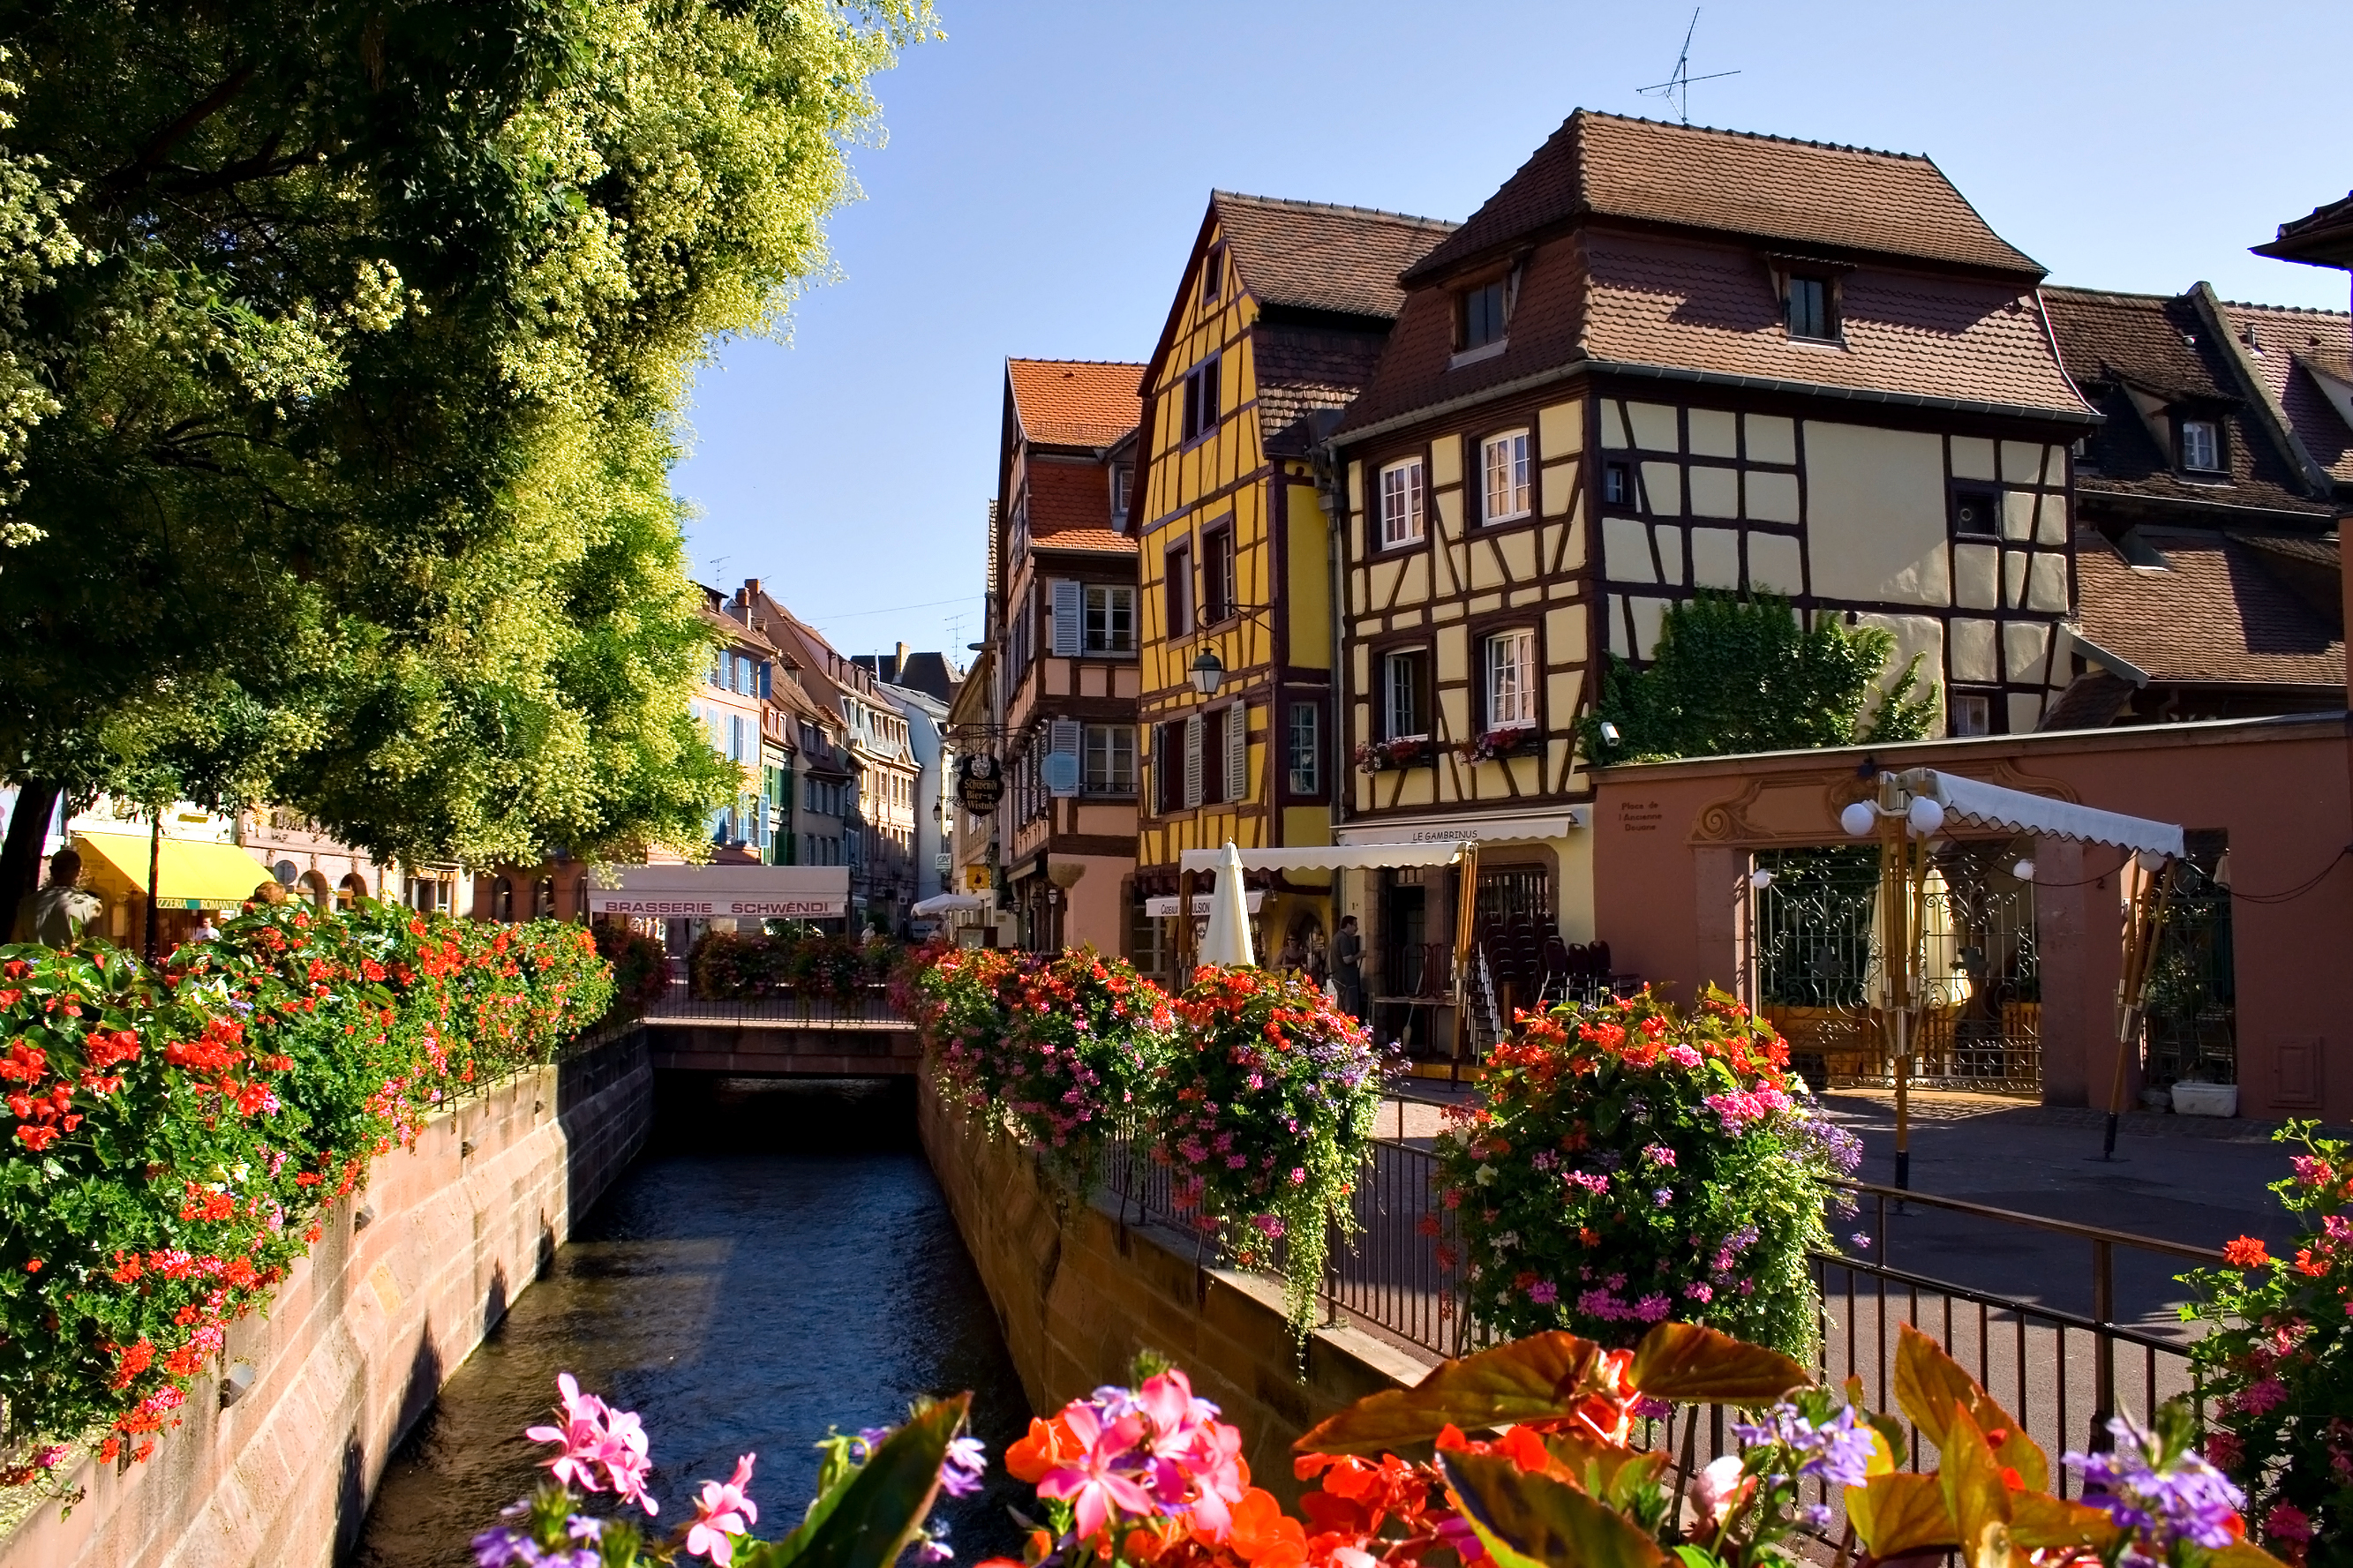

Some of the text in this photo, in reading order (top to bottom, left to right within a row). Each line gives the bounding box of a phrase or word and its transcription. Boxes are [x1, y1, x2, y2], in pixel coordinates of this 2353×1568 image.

[964, 778, 997, 791] Schwendi
[966, 800, 994, 810] Wistub
[1413, 830, 1477, 841] LE GAMBRINUS
[605, 901, 828, 914] BRASSERIE SCHWENDI
[1192, 902, 1210, 913] ULSION
